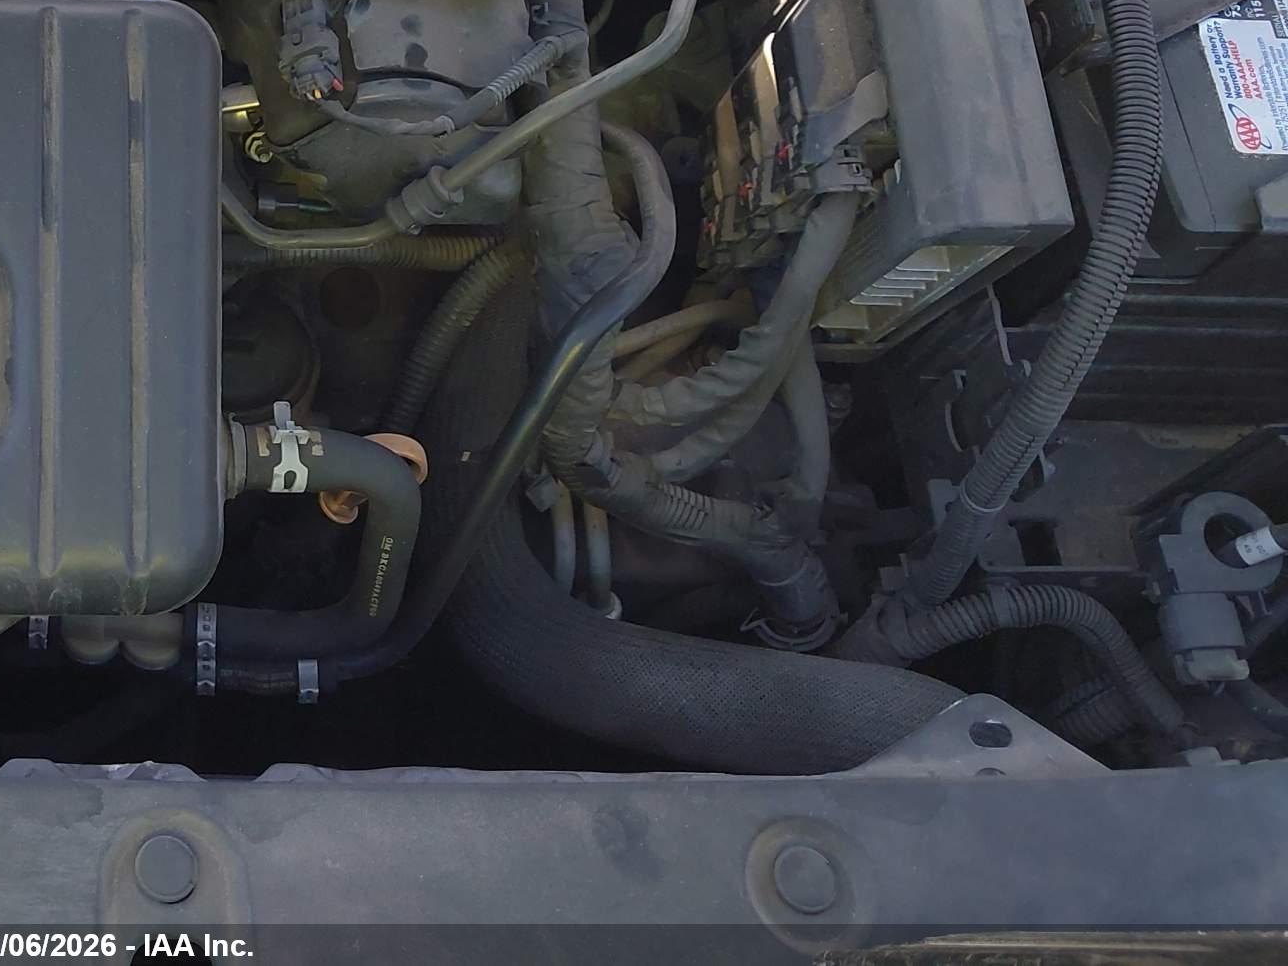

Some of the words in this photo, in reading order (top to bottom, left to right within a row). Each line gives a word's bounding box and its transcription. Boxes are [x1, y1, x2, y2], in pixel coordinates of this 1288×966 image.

[1250, 0, 1265, 18] 115
[1206, 23, 1214, 33] or
[1213, 20, 1231, 59] Support?
[1209, 35, 1222, 65] Battery
[1220, 74, 1233, 99] Need
[1225, 61, 1242, 99] Warranty
[1245, 58, 1263, 99] AAA.com
[1236, 118, 1261, 149] AAA
